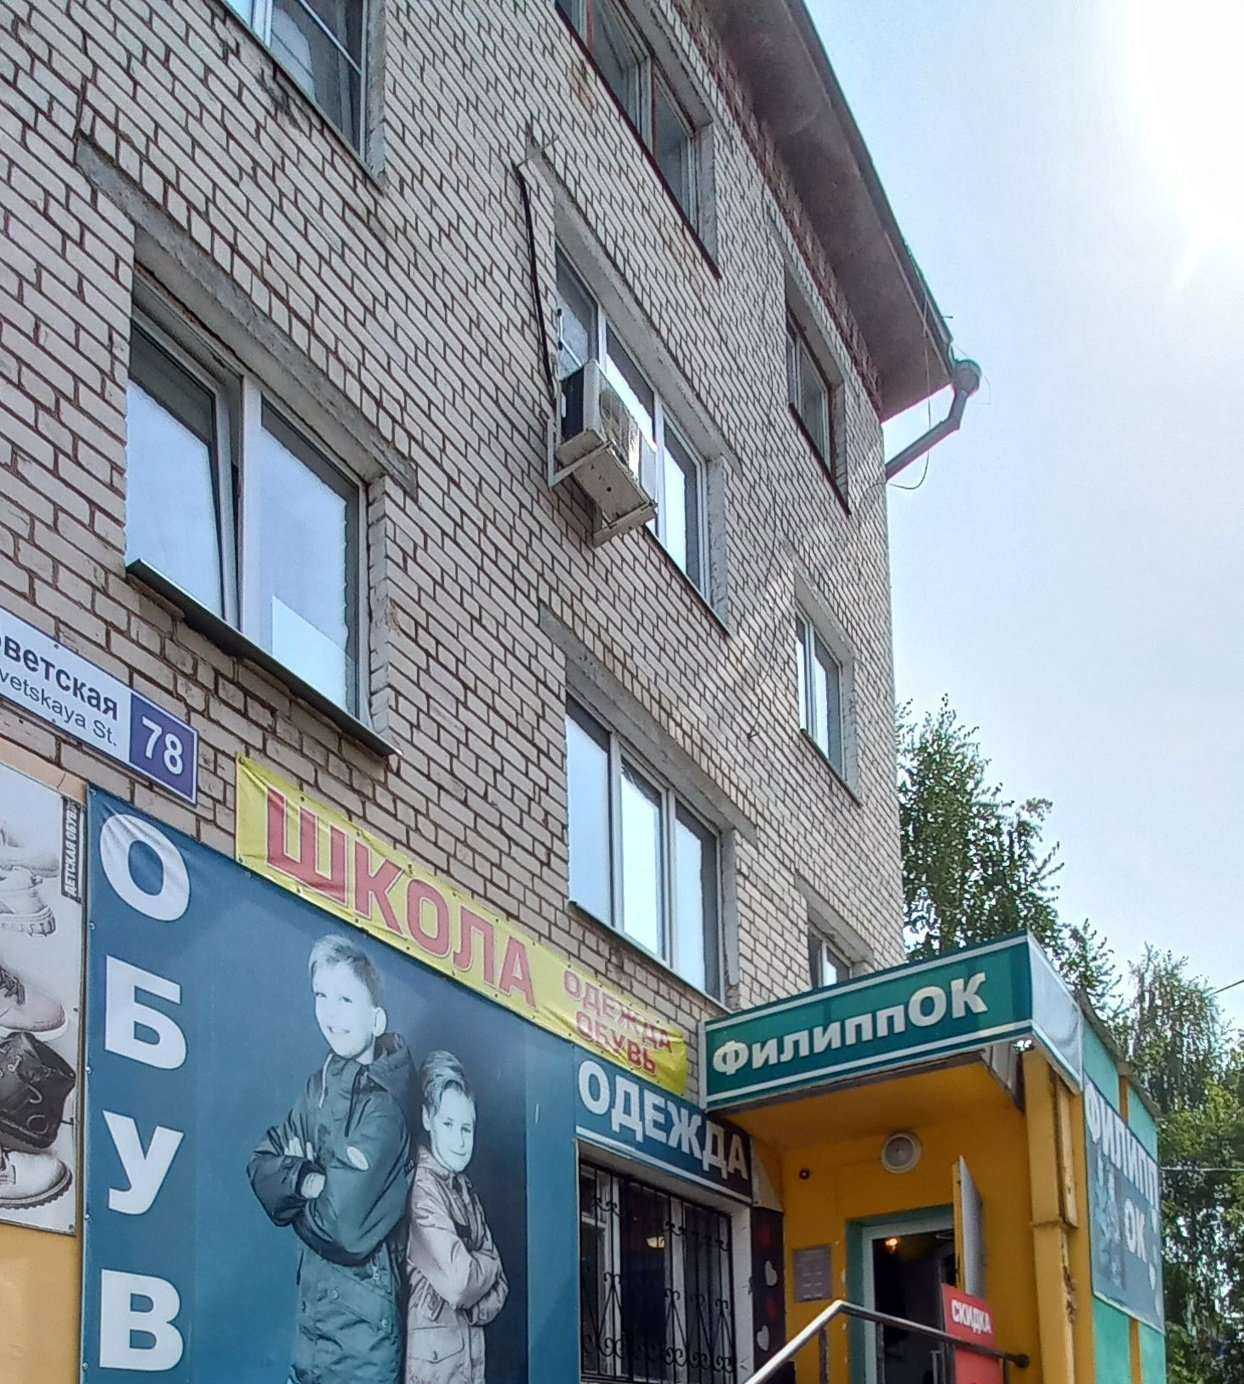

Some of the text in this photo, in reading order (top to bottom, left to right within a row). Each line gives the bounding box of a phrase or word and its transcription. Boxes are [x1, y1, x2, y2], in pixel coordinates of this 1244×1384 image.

[0, 635, 118, 721] ветская
[93, 719, 117, 747] St.
[141, 715, 183, 775] 78
[64, 840, 78, 897] ДЕТСКАЯ
[266, 787, 536, 1010] ШКОЛА
[563, 969, 672, 1054] ОДЕЖДА
[711, 971, 989, 1076] ФилиппОК
[578, 1059, 749, 1181] ОДЕЖДА
[1124, 1197, 1148, 1265] ОК
[950, 1299, 992, 1335] СКИДКА
